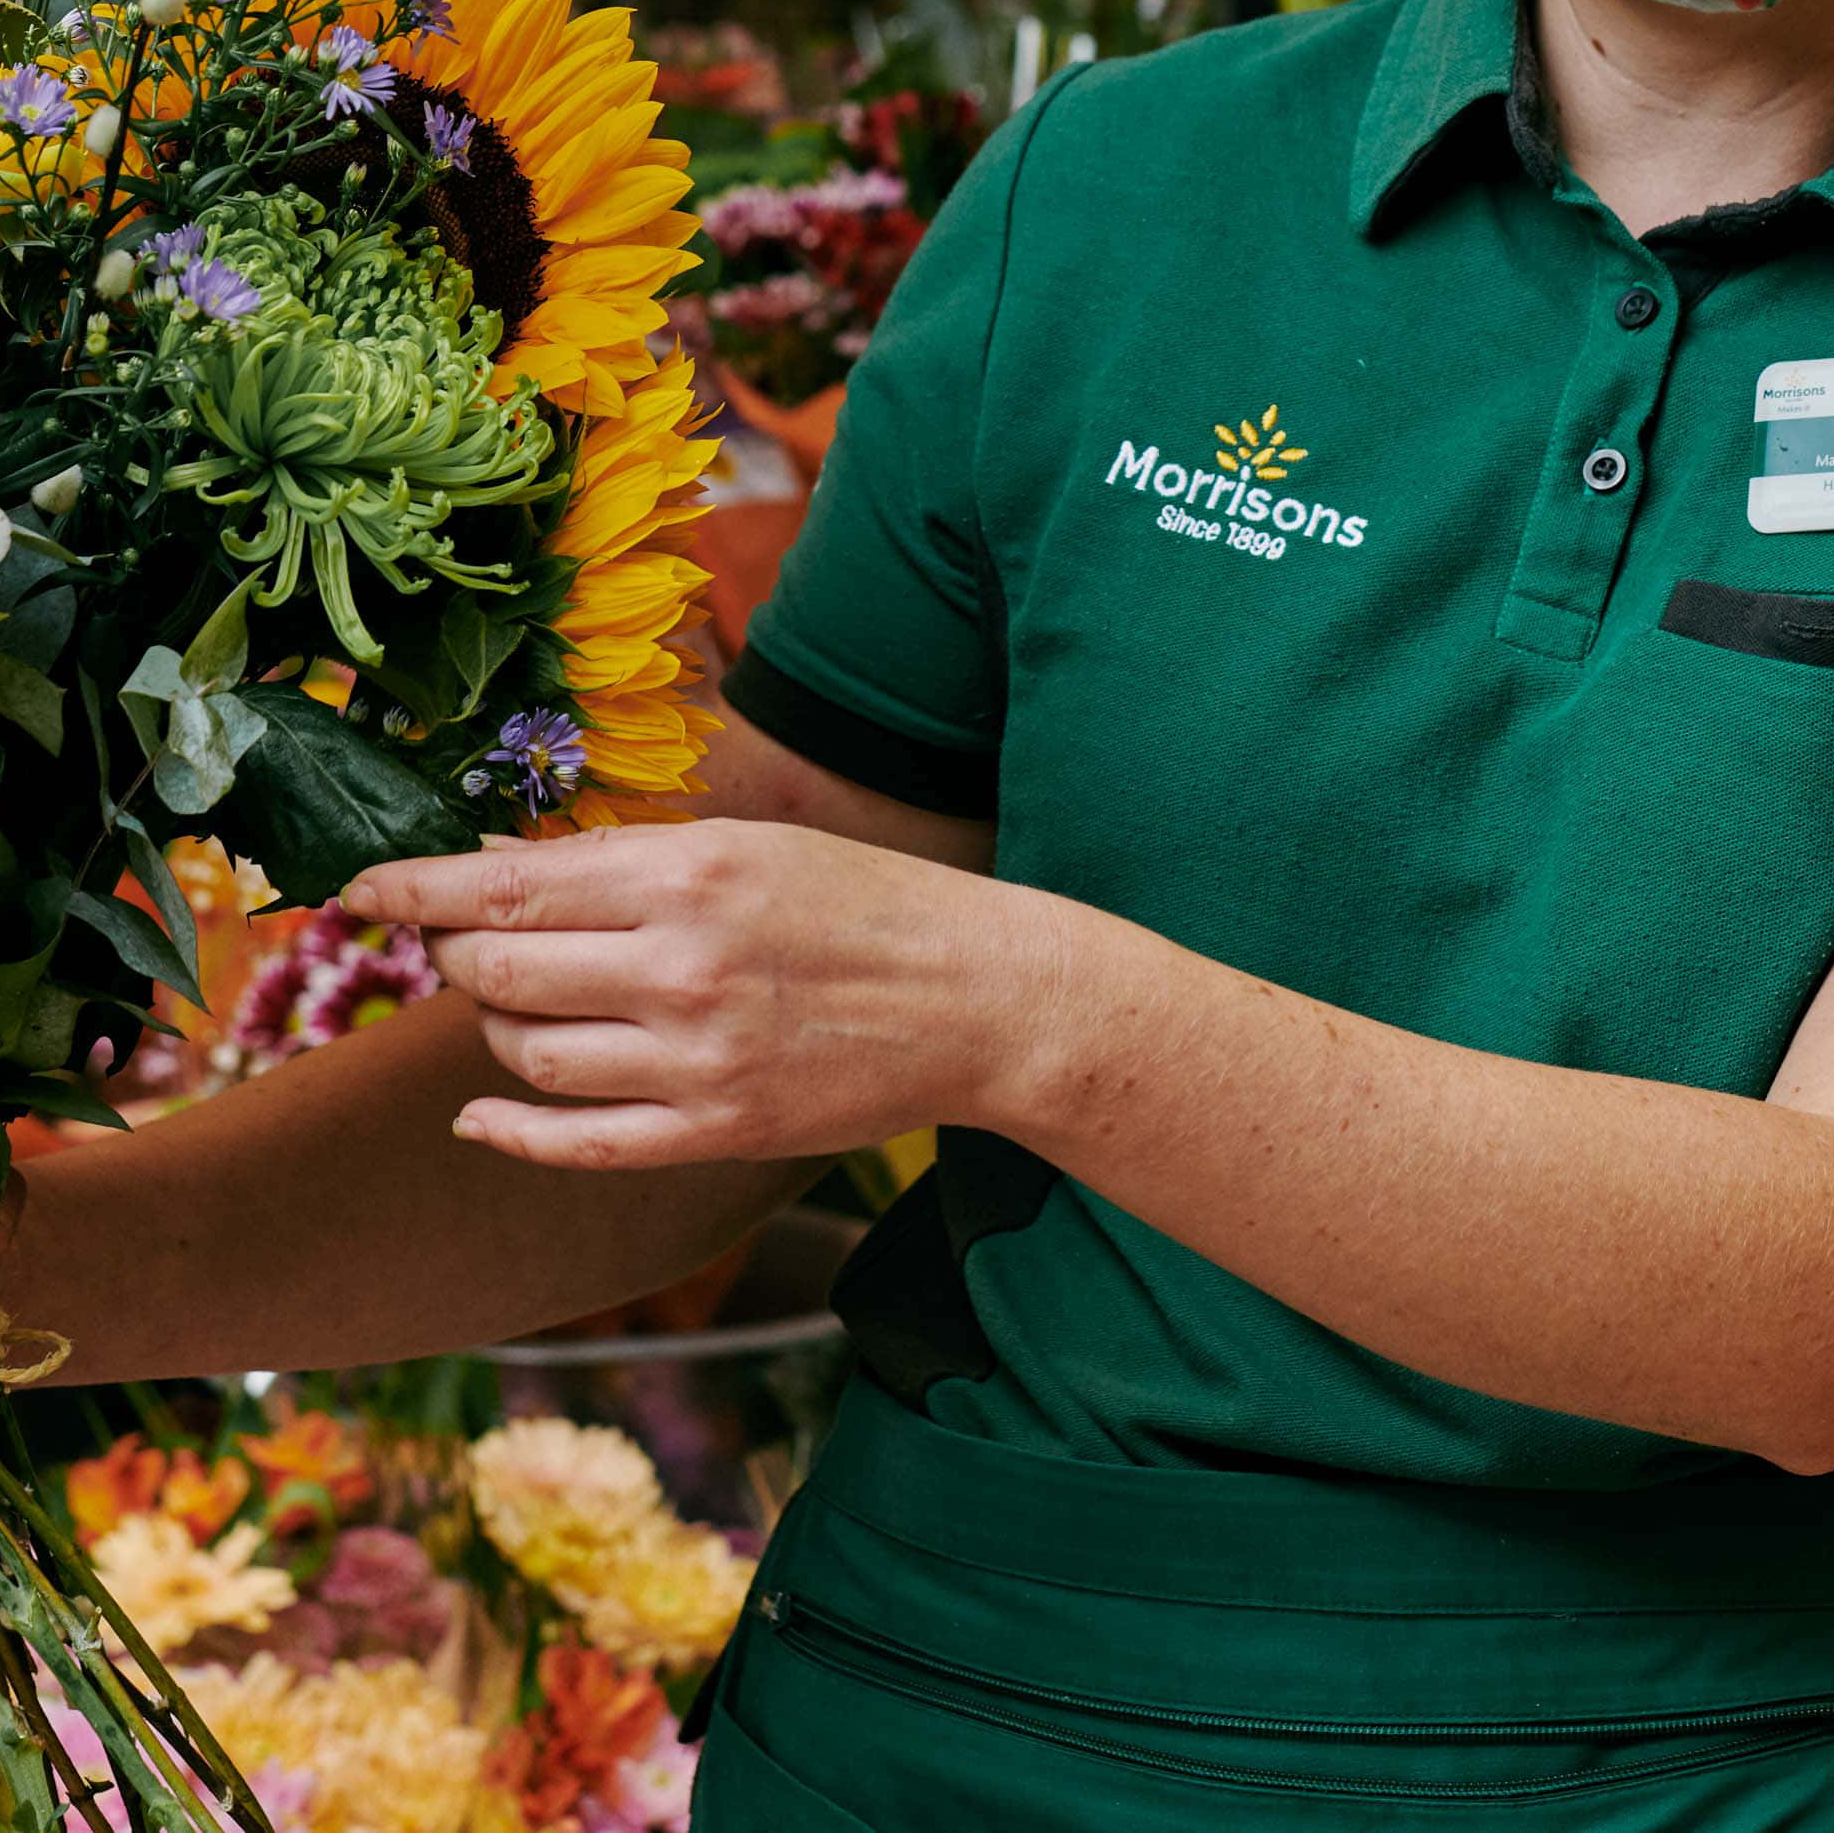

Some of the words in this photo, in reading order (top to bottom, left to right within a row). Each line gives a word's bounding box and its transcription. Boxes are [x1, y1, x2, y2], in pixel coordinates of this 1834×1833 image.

[1763, 385, 1826, 399] Morrisons
[1106, 440, 1368, 548] Morrisons
[1157, 504, 1221, 541] Since
[1226, 522, 1287, 560] 1899
